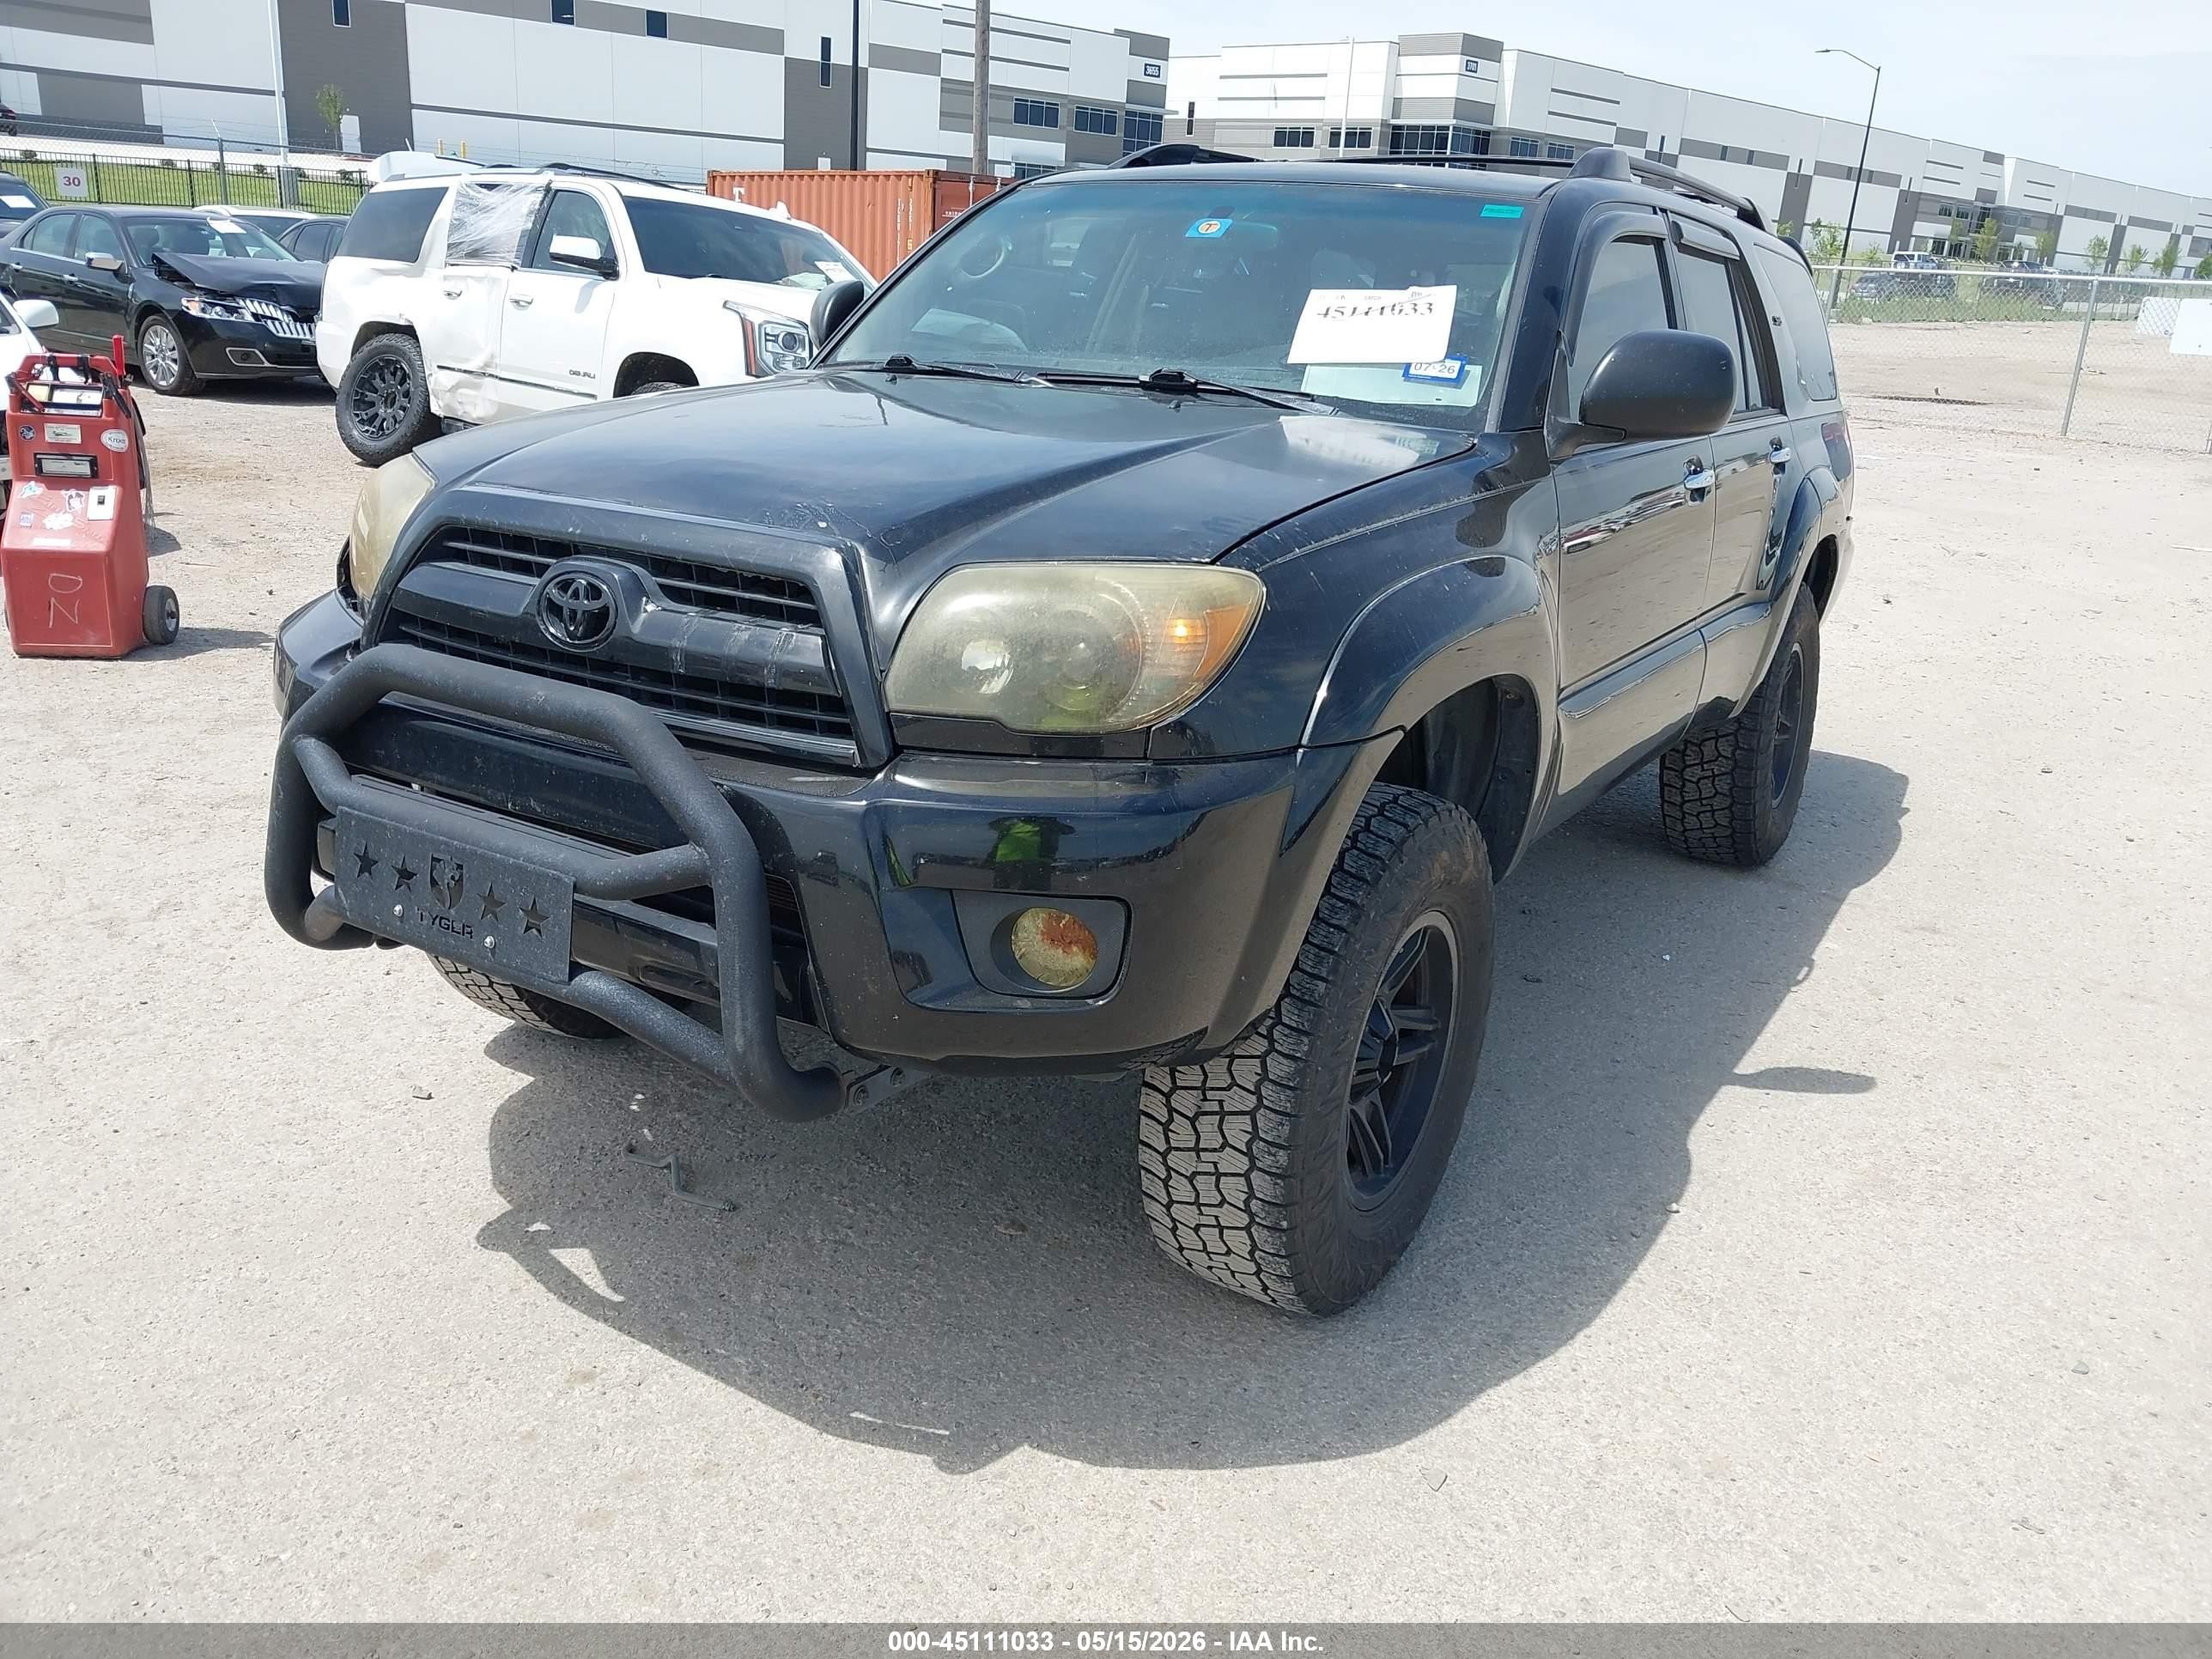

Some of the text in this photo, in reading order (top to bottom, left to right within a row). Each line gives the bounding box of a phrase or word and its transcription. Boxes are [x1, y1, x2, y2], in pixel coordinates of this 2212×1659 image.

[1146, 65, 1159, 76] 3655
[63, 176, 81, 186] 30
[1414, 362, 1455, 374] 07 26
[416, 907, 473, 939] TYGER
